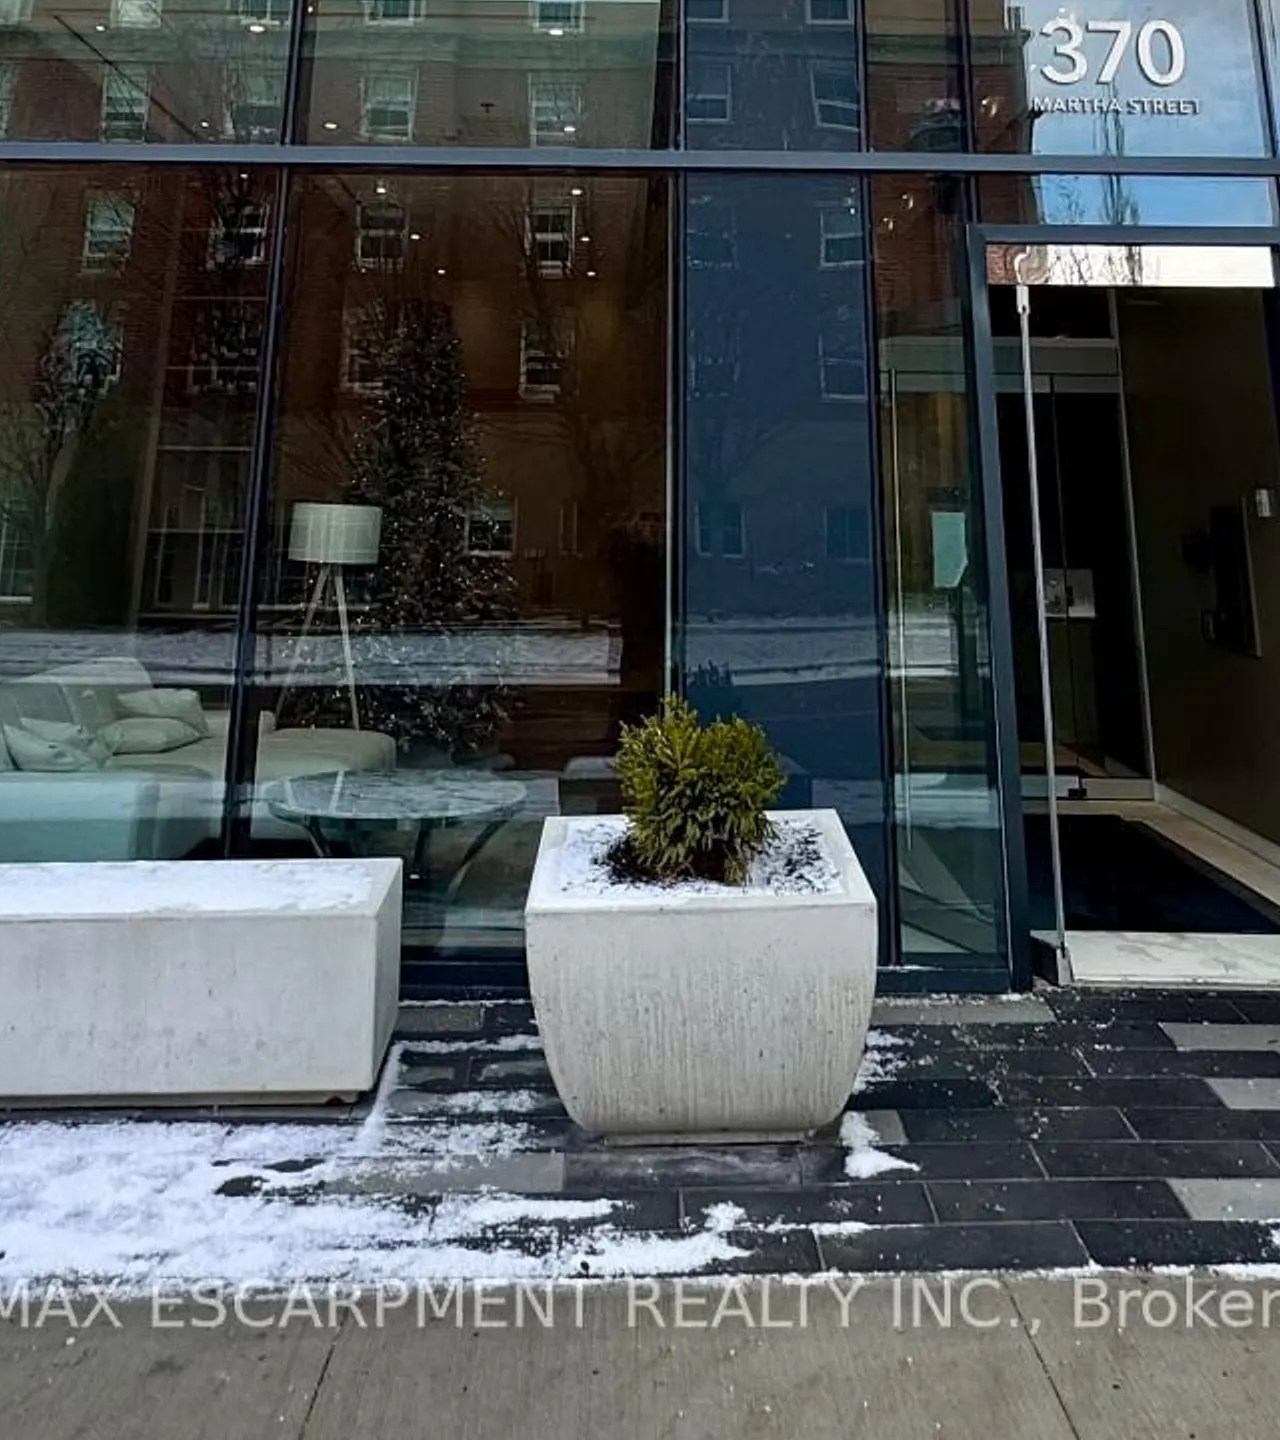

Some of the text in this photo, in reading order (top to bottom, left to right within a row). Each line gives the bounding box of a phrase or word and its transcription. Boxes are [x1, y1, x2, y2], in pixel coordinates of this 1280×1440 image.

[1040, 19, 1186, 86] 370
[1033, 96, 1201, 115] MARTHA STREET
